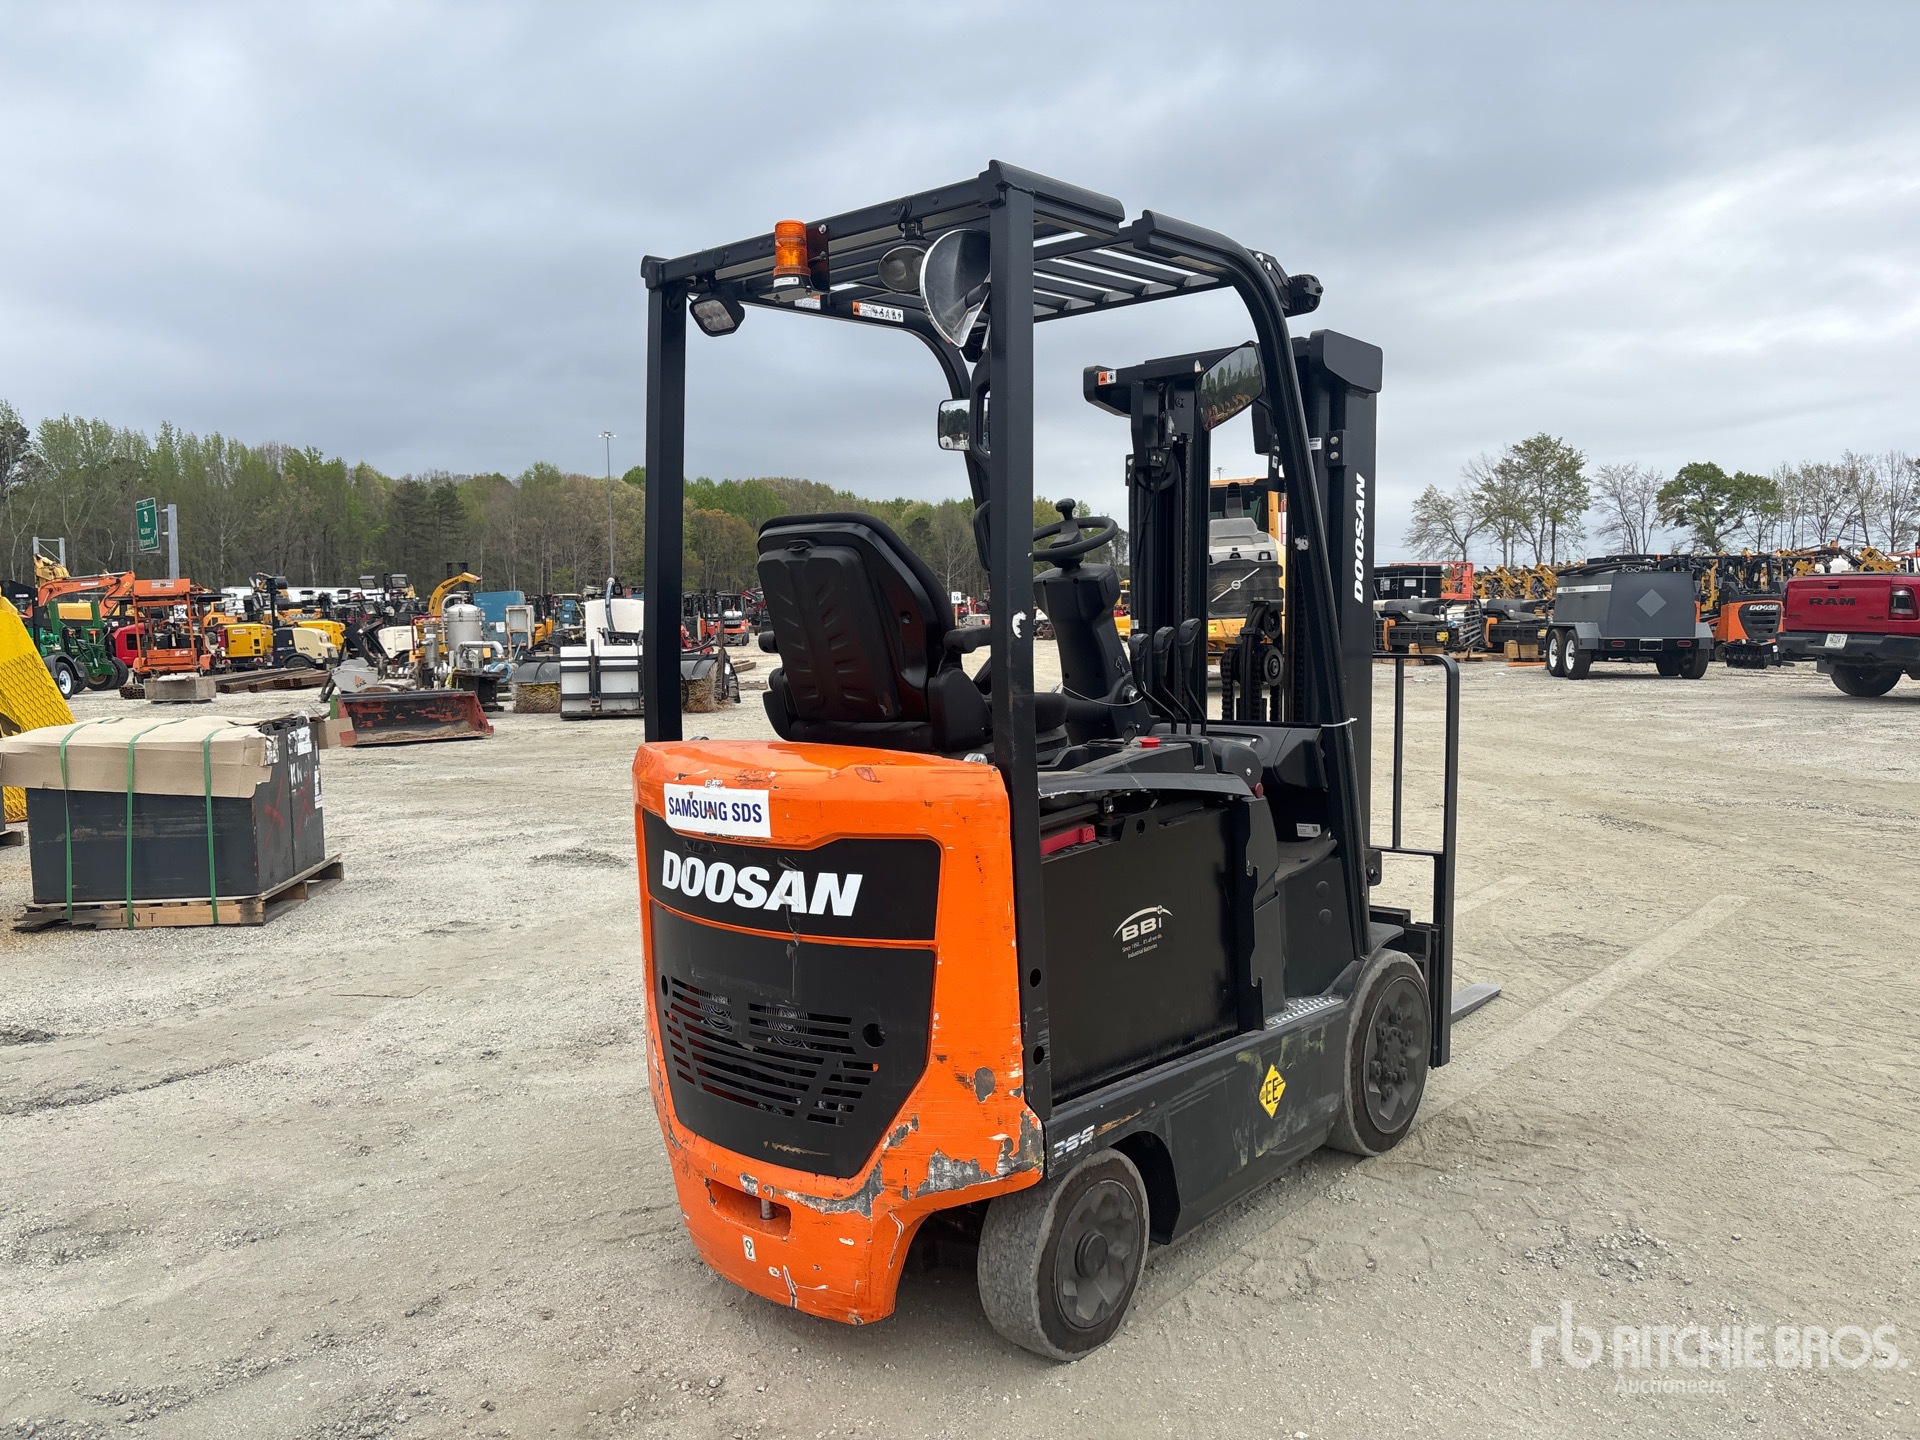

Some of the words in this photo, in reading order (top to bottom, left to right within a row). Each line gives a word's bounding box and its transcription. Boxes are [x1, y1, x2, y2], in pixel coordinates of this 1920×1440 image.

[1354, 472, 1366, 604] DOOSAN
[440, 578, 460, 590] Vermeer
[1808, 597, 1856, 606] RAM
[668, 796, 728, 821] SAMSUNG
[731, 802, 762, 823] SDS
[662, 849, 864, 917] DOOSAN
[1127, 947, 1144, 959] Industrial
[1143, 943, 1158, 953] Batteries
